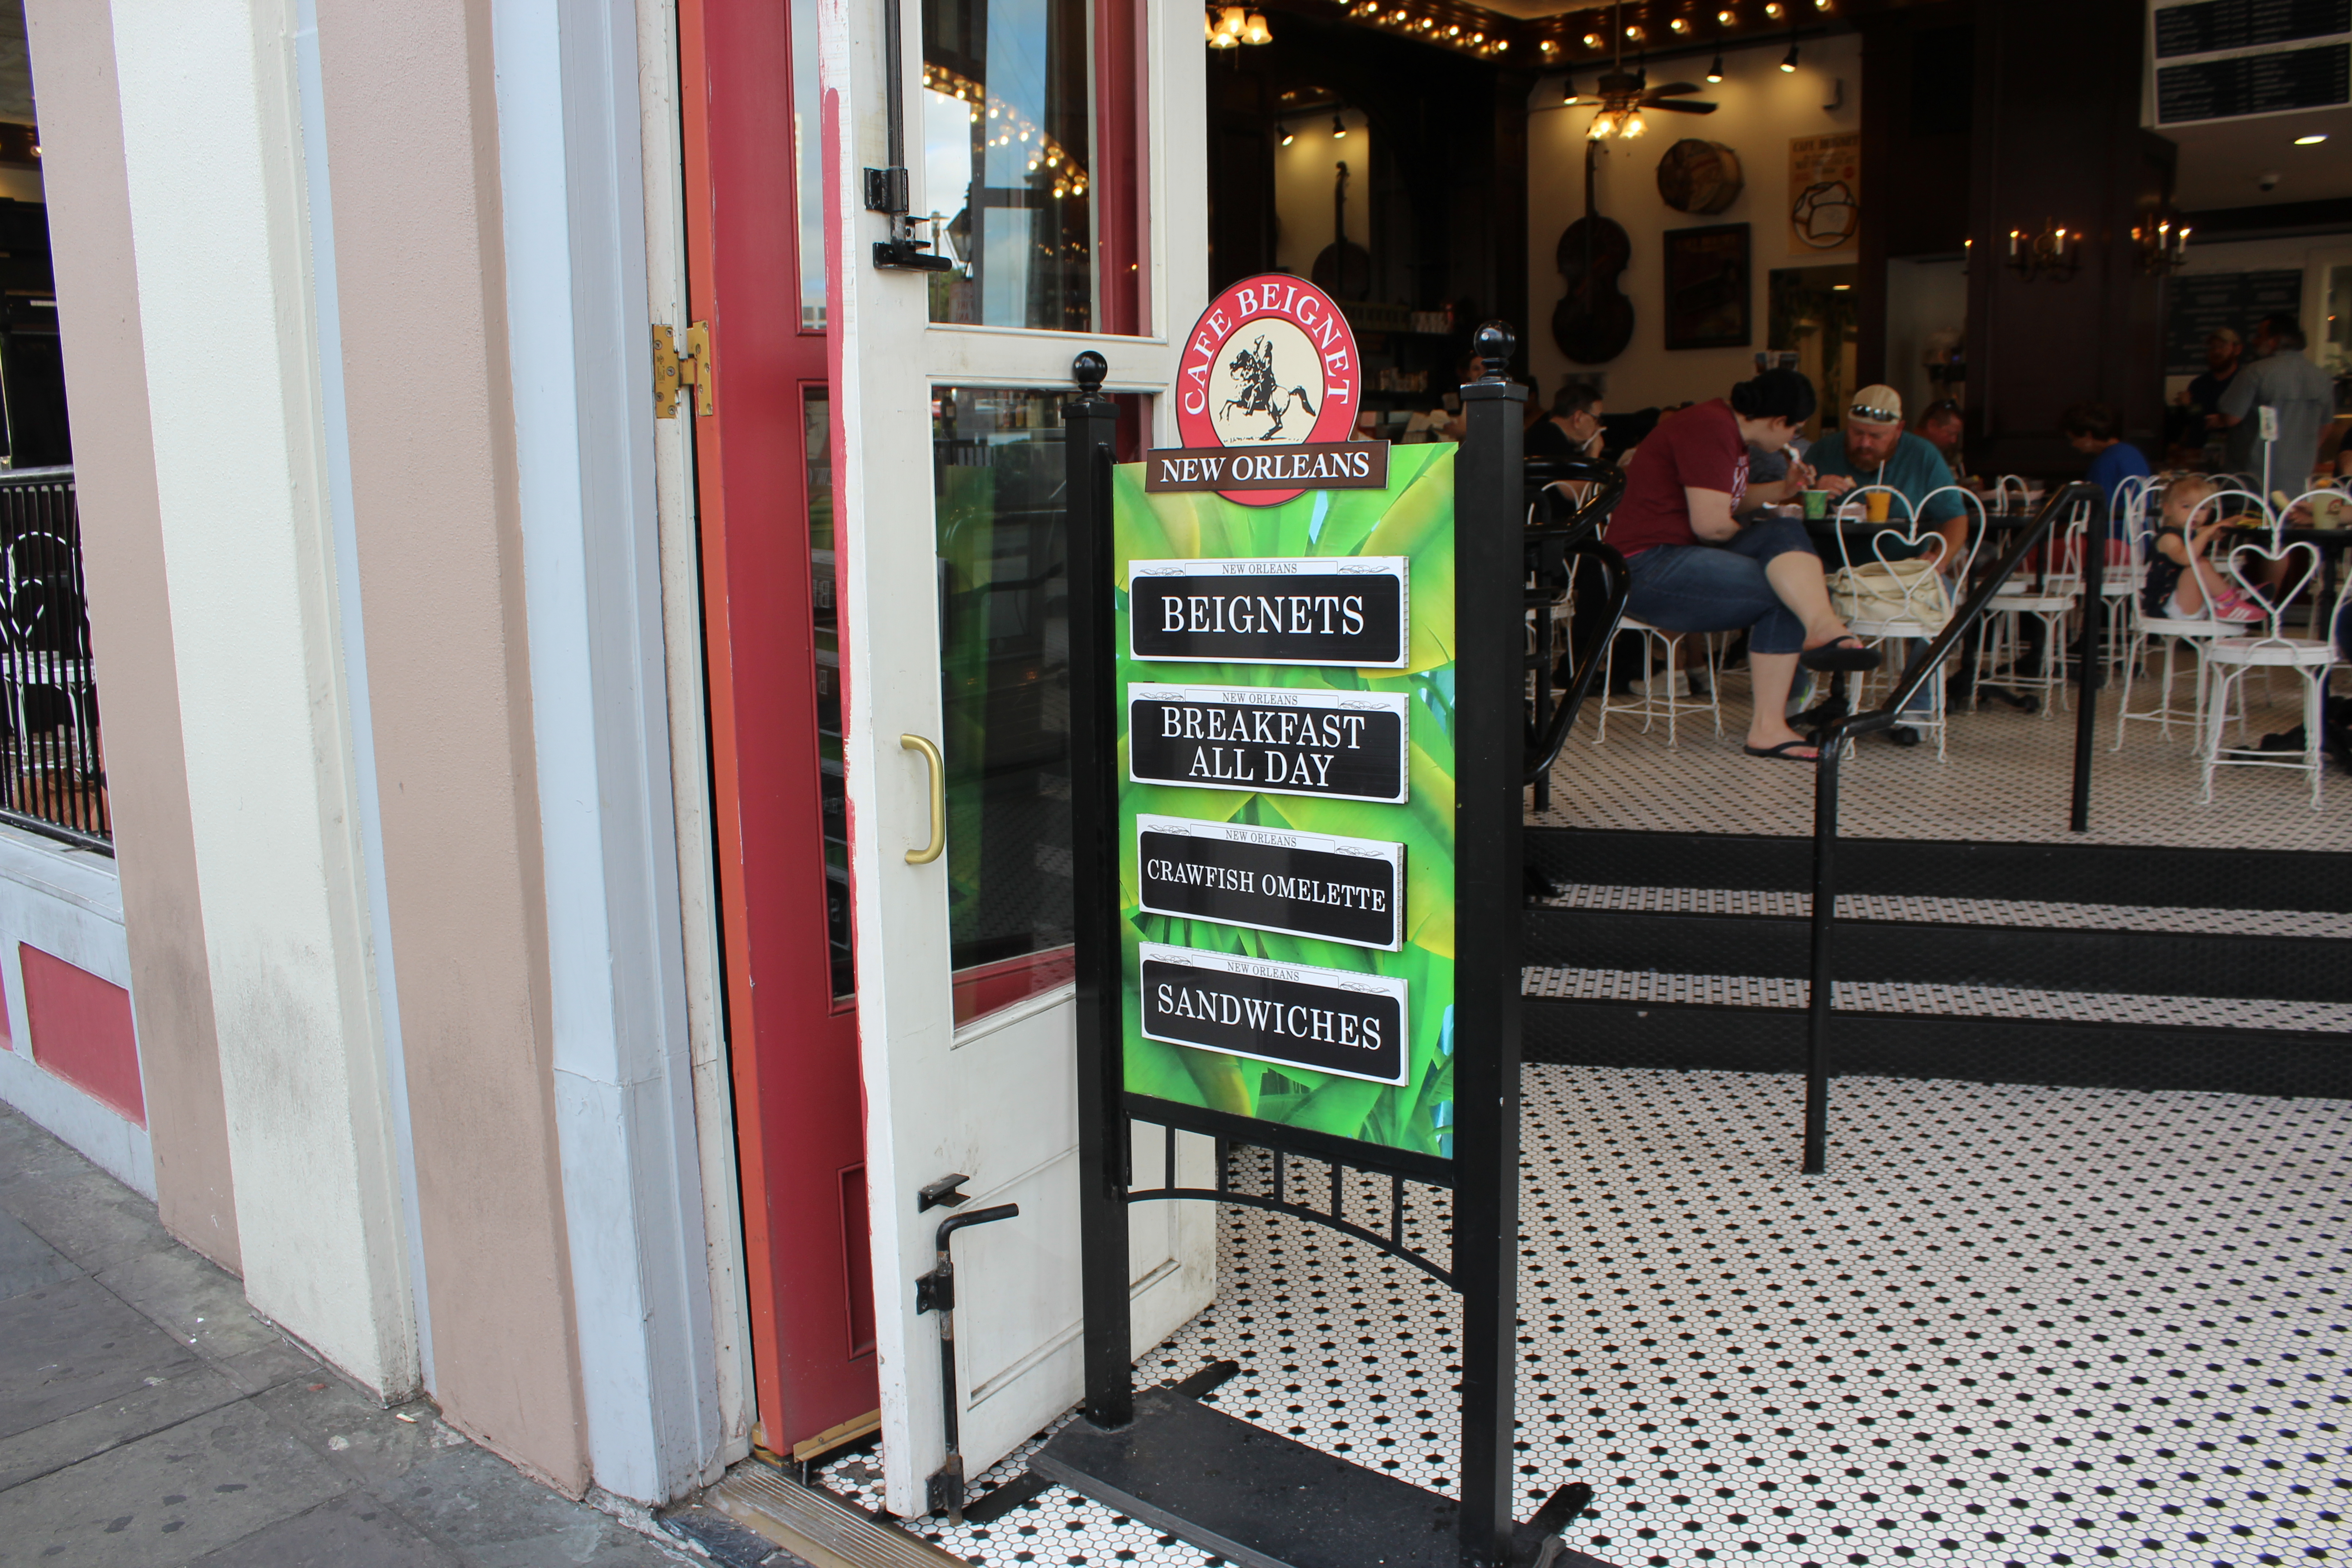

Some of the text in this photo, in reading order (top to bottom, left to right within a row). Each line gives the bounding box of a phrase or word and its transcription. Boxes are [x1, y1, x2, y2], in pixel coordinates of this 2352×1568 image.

[1185, 283, 1351, 415] CAFE BEIGNET
[1160, 451, 1370, 482] NEW ORLEANS
[1222, 563, 1298, 574] NEW ORLEANS
[1161, 596, 1364, 635] BEIGNETS
[1222, 692, 1298, 706] NEW ORLEANS
[1161, 706, 1365, 749] BREAKFAST
[1188, 745, 1335, 787] ALL DAY
[1225, 829, 1297, 848] NEW ORLEANS
[1147, 859, 1386, 912] CRAWFISH OMELETTE
[1227, 961, 1300, 981] NEW ORLEANS
[1157, 983, 1382, 1051] SANDWICHES
